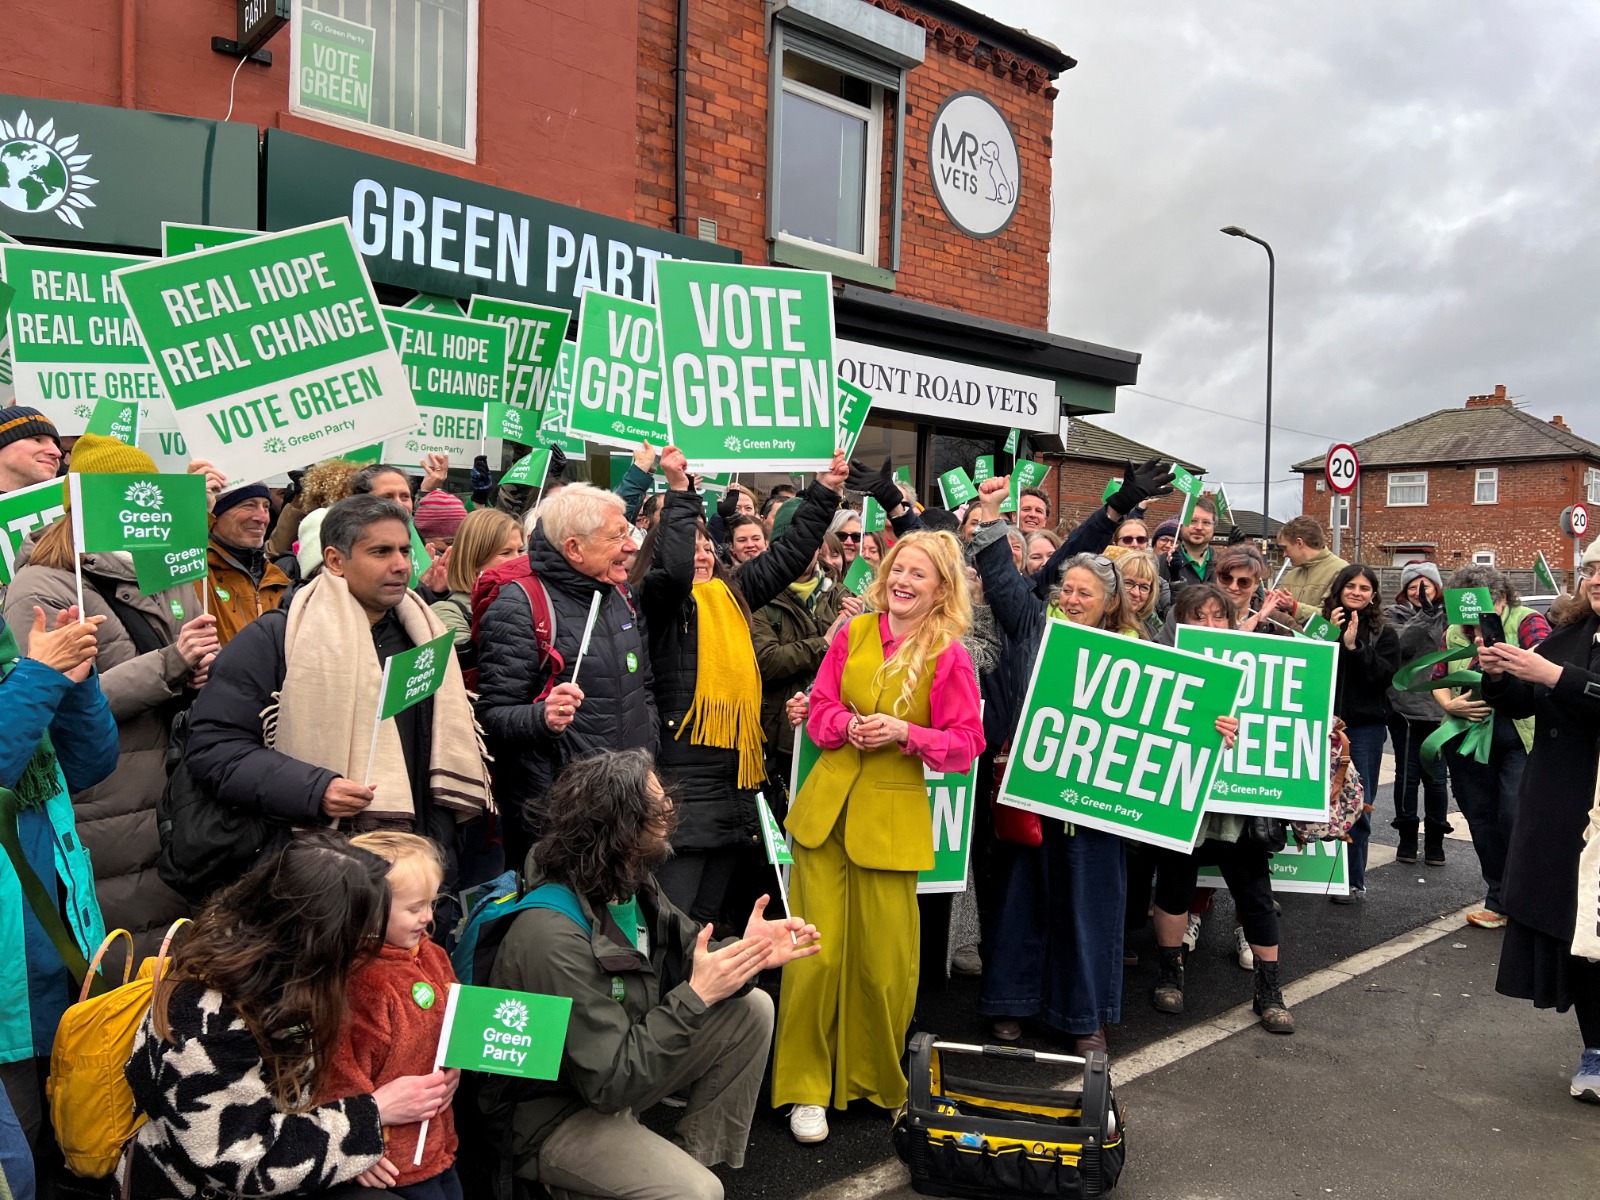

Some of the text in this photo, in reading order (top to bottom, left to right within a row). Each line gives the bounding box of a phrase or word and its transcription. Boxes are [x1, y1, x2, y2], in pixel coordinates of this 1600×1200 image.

[324, 26, 366, 45] Green Party
[312, 43, 360, 79] VOTE
[300, 66, 368, 109] GREEN
[940, 122, 978, 171] MR
[940, 163, 978, 195] VETS
[352, 178, 690, 304] GREEN PART
[31, 269, 96, 304] REAL
[159, 275, 252, 328] REAL
[249, 251, 336, 305] HOPE
[688, 281, 806, 352] VOTE
[17, 312, 84, 345] REAL
[160, 297, 375, 387] REAL CHANGE
[403, 328, 490, 364] EAL HOPE
[37, 371, 166, 400] VOTE GREE
[427, 366, 500, 399] CHANGE
[671, 352, 830, 428] GREEN
[837, 357, 1039, 416] OUNT ROAD VETS
[205, 394, 289, 445] VOTE
[289, 365, 384, 420] GREEN
[110, 422, 132, 433] Green
[287, 418, 356, 448] Green Party
[432, 414, 485, 441] GREEN
[501, 419, 524, 431] Green
[502, 427, 523, 439] Party
[626, 425, 651, 437] Green
[420, 443, 465, 455] Green Party
[742, 439, 796, 451] Green Party
[1019, 471, 1035, 480] Green
[1331, 457, 1355, 478] 20
[950, 483, 966, 494] Green
[954, 490, 969, 500] Party
[119, 509, 173, 524] Green
[1573, 512, 1586, 527] 20
[123, 525, 171, 541] Party
[164, 548, 204, 565] Green
[169, 557, 205, 577] Party
[1459, 605, 1482, 613] Green
[406, 667, 436, 688] Green
[404, 680, 433, 701] Party
[1072, 647, 1205, 736] VOTE
[1222, 712, 1323, 782] EEN
[1022, 706, 1212, 813] GREEN
[1230, 783, 1283, 800] Green Party
[1080, 795, 1143, 822] Green Party
[1273, 863, 1298, 876] Party
[482, 1027, 532, 1048] Green
[482, 1044, 528, 1067] Party
